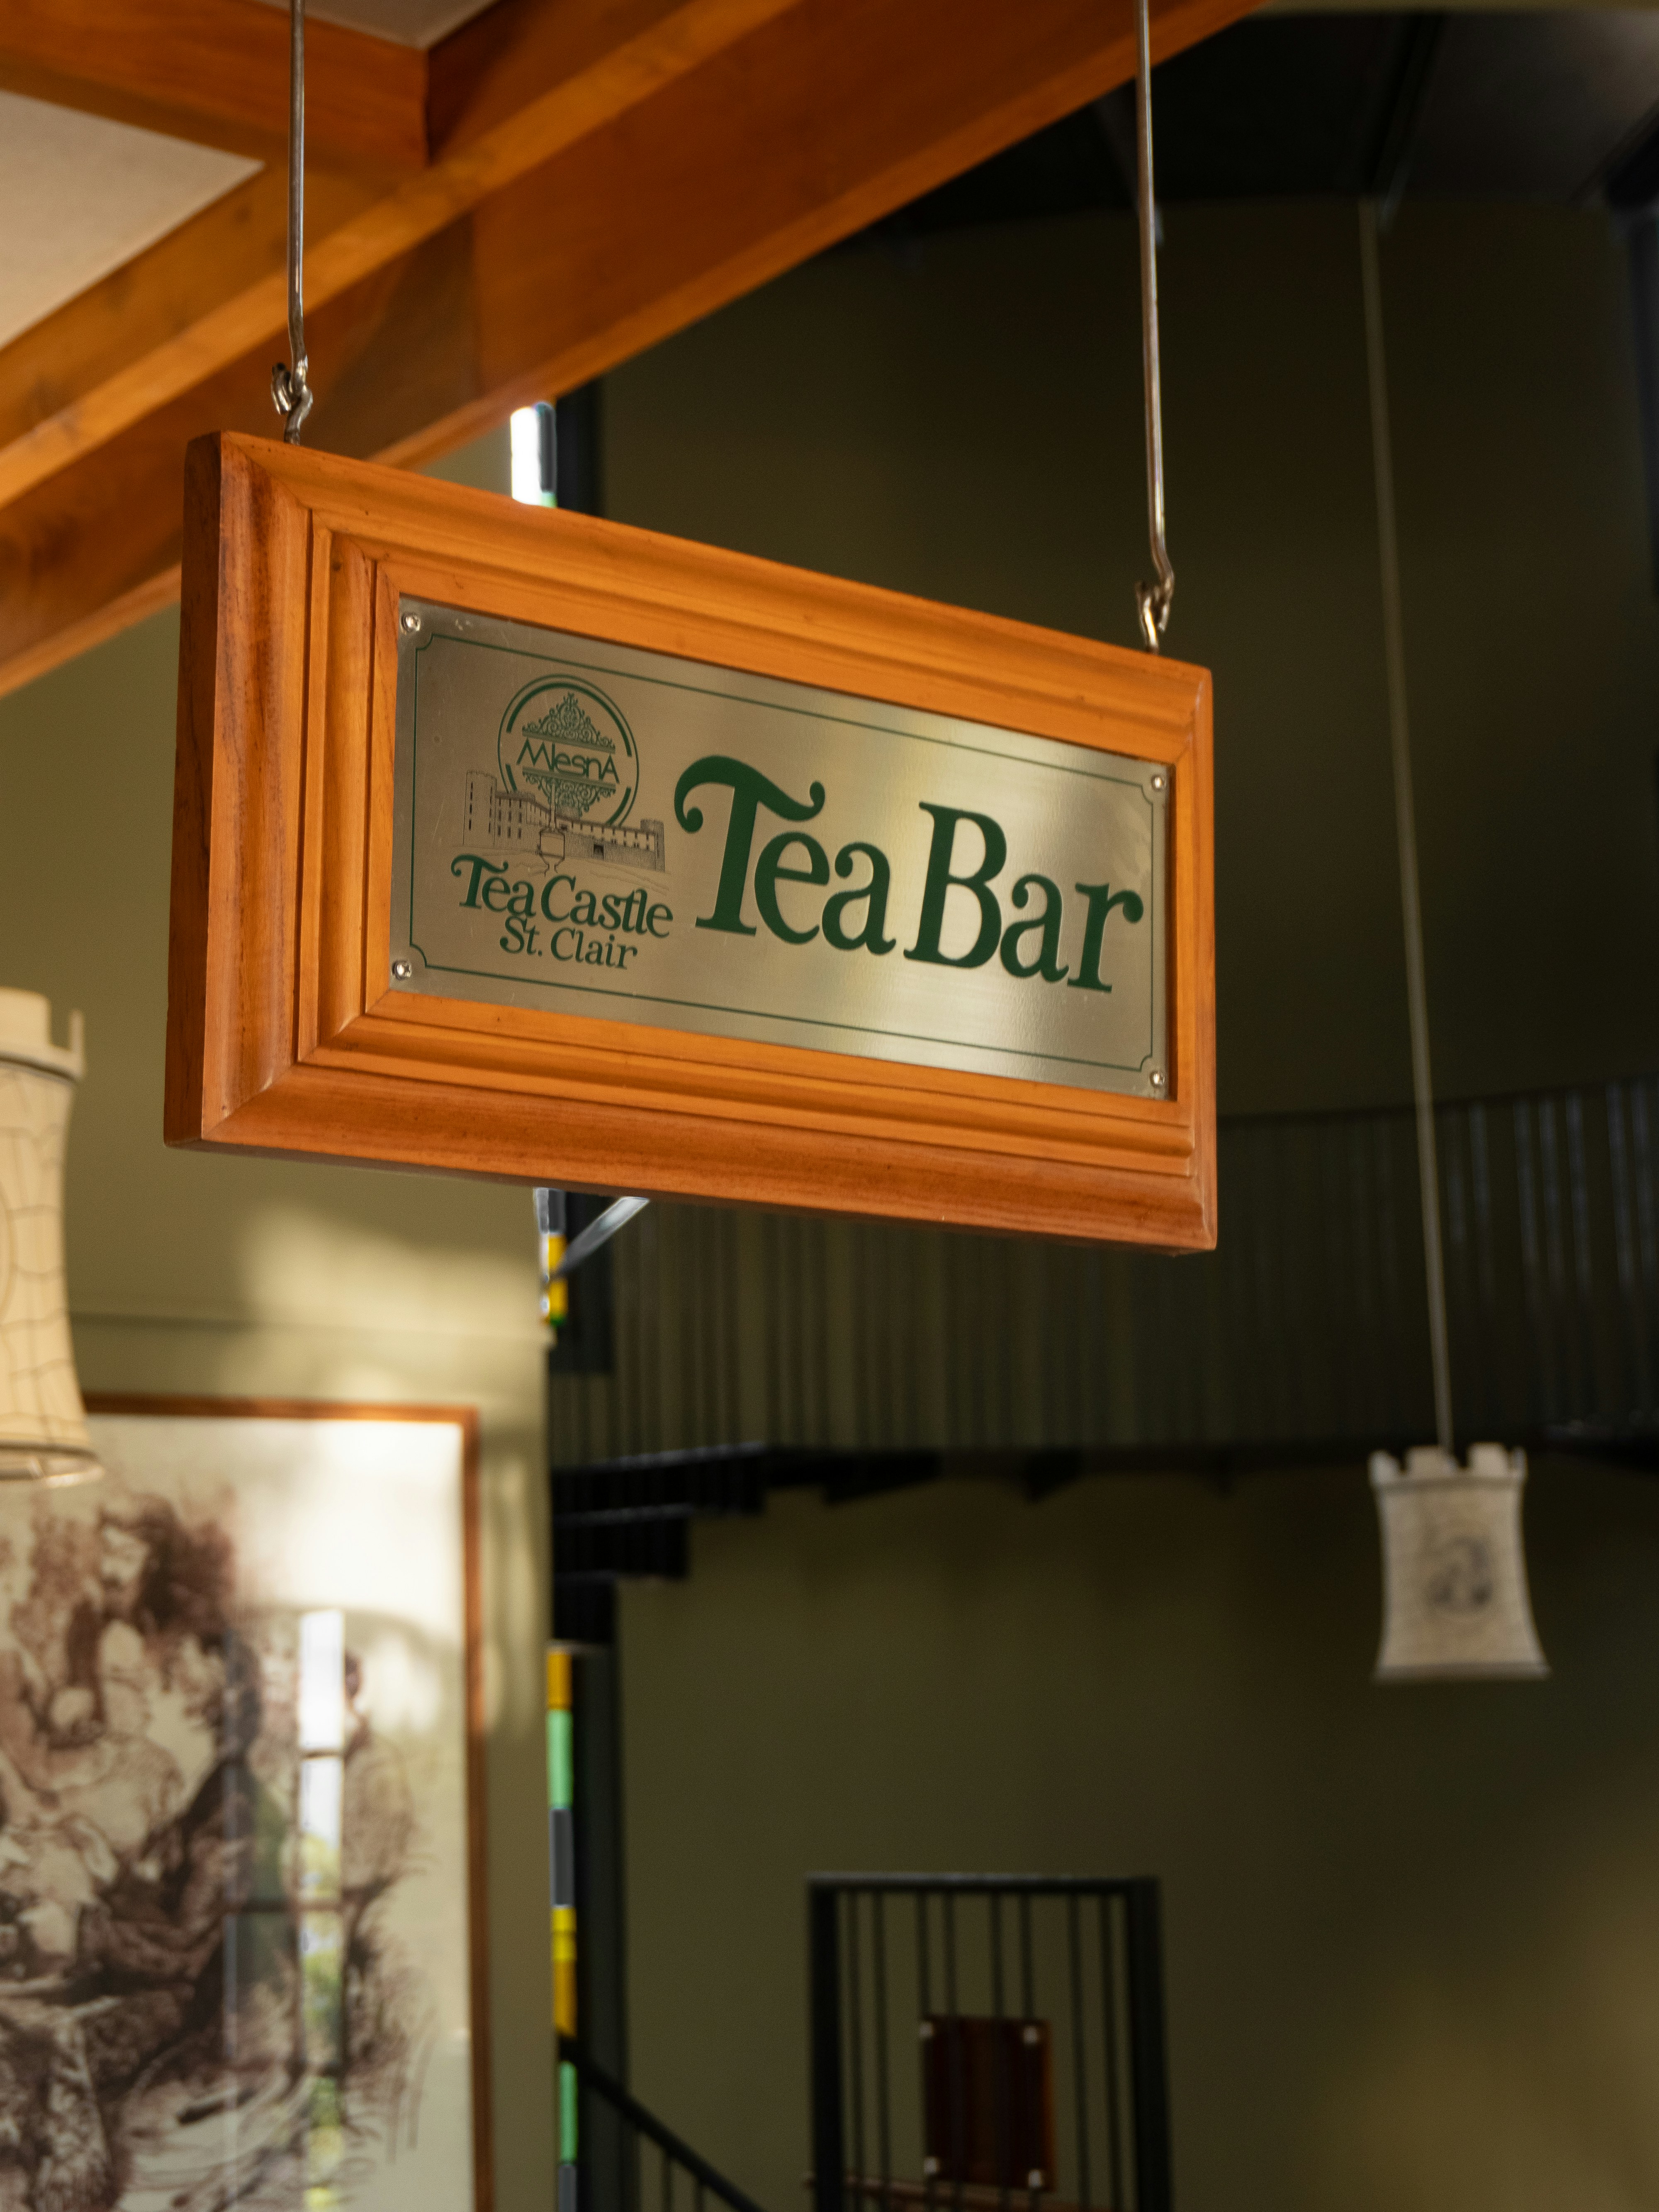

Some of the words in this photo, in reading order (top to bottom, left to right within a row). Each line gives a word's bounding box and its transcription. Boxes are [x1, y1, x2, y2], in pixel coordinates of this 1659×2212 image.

[450, 853, 537, 917] Tea
[540, 874, 674, 939] Castle
[674, 754, 897, 956] Tea
[903, 801, 1144, 993] Bar
[499, 915, 542, 957] St.
[550, 927, 638, 970] Clair
